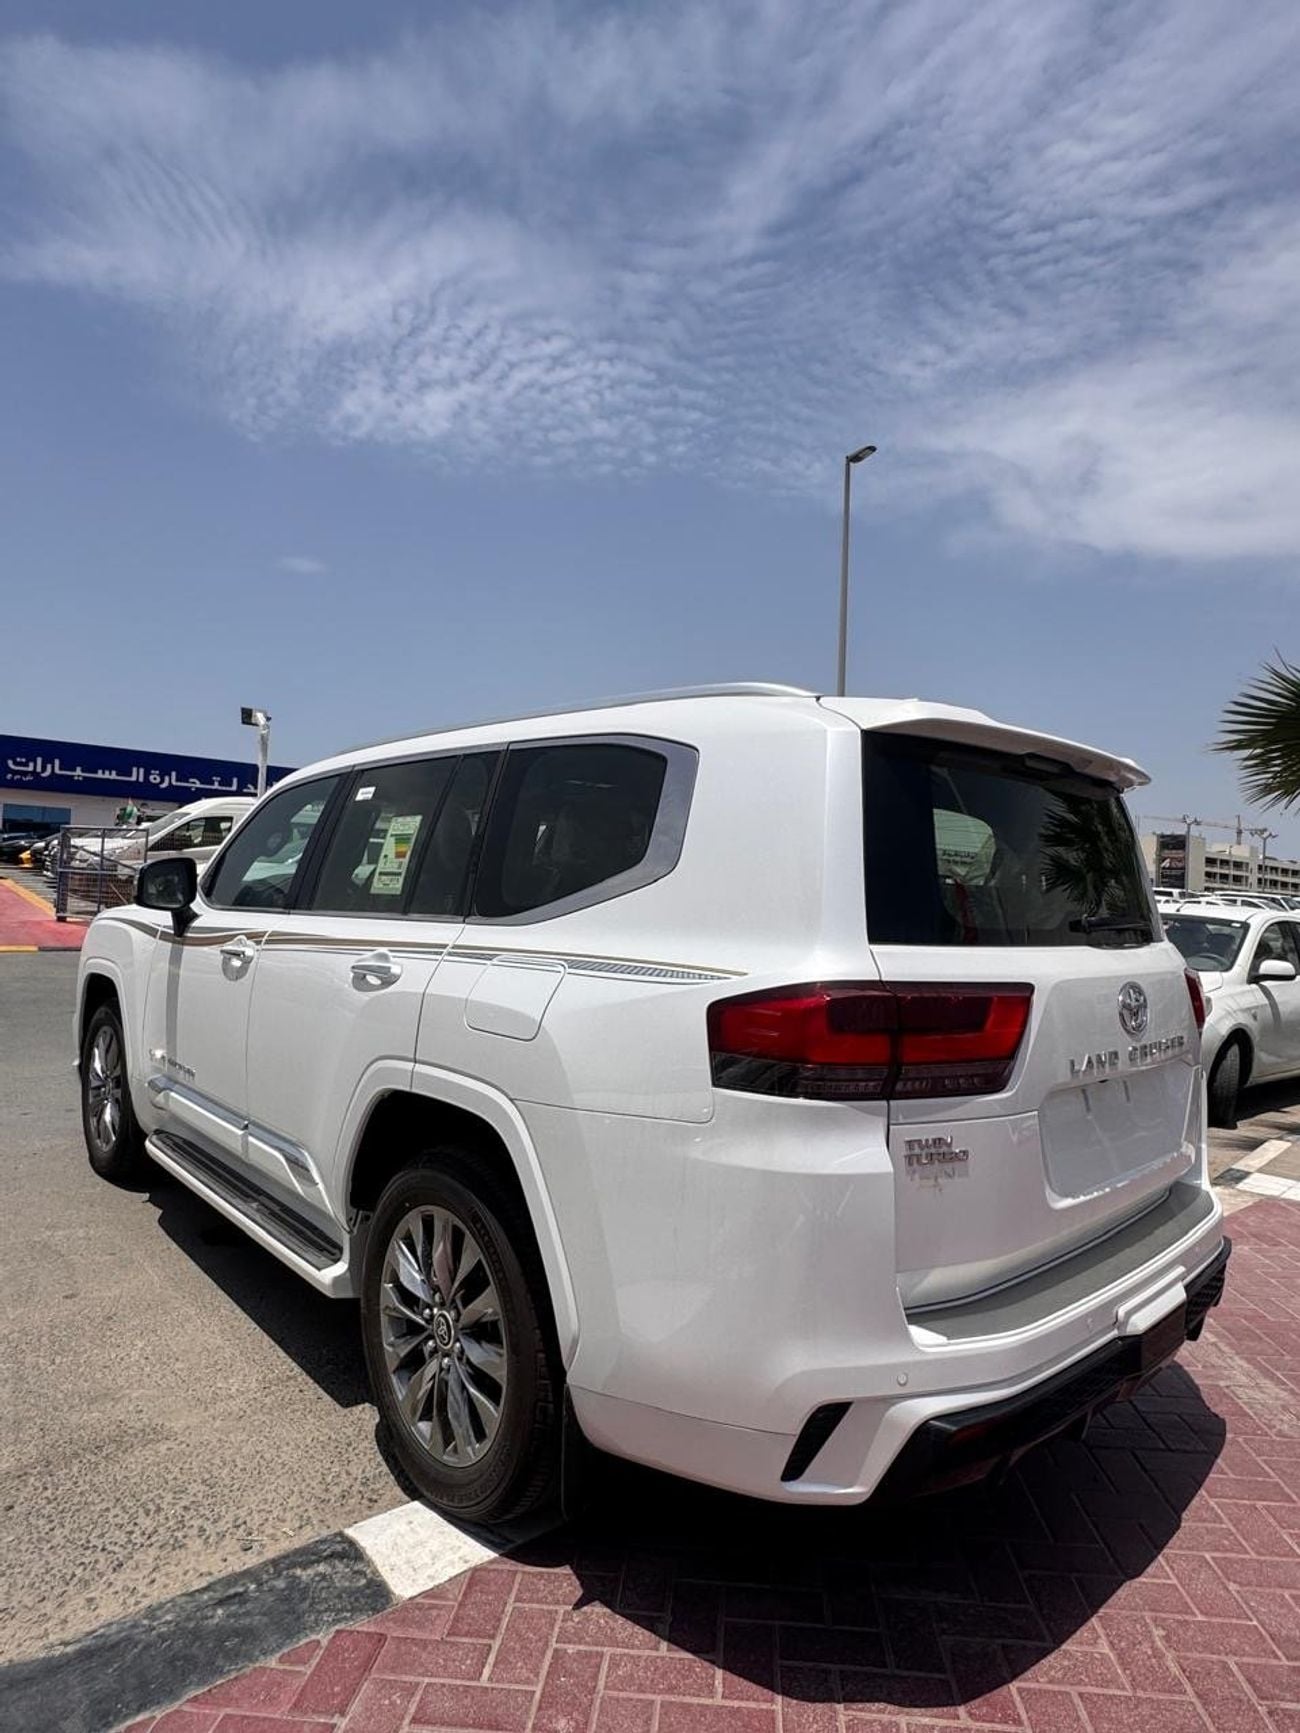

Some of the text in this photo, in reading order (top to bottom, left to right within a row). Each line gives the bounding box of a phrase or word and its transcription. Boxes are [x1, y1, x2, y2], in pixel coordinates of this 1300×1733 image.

[7, 756, 145, 783] السيارات
[149, 770, 238, 792] لتجارة
[1069, 1035, 1185, 1074] LAND CRUISER
[904, 1136, 953, 1151] TWIN
[904, 1149, 969, 1166] TURBO
